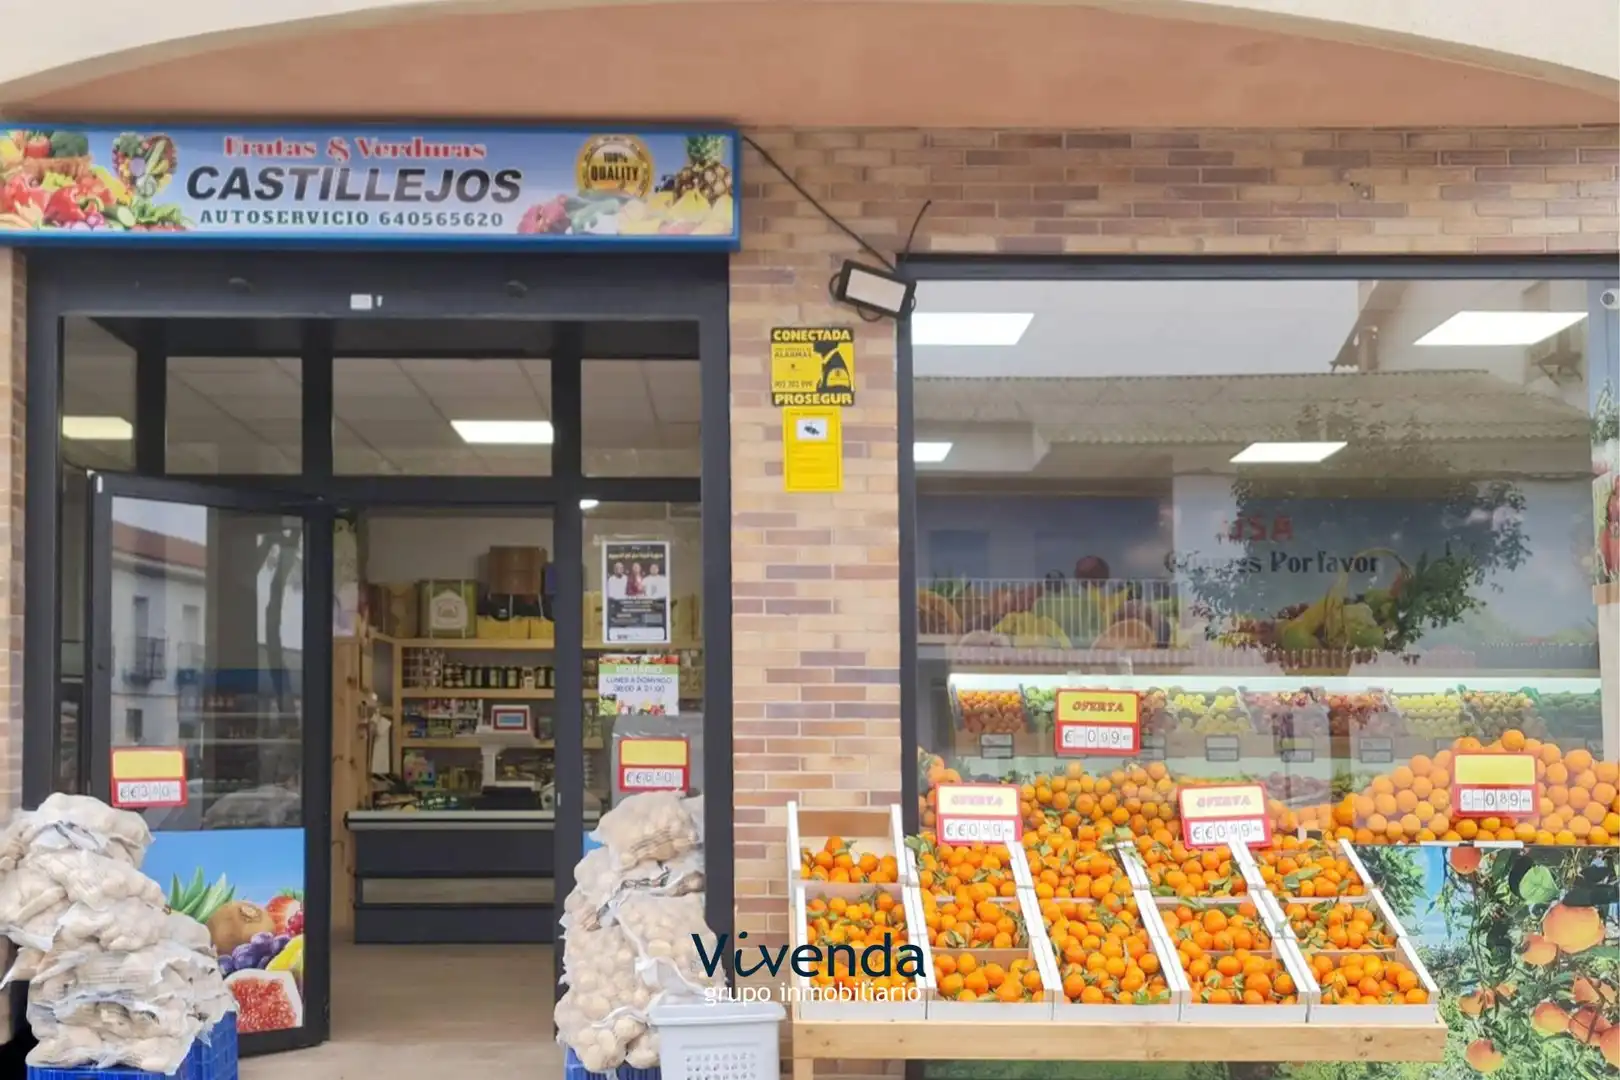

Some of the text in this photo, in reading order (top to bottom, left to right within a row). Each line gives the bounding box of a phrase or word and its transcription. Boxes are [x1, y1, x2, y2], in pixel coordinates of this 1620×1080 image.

[224, 136, 487, 161] Frutas & Verduras
[591, 166, 638, 181] QUALITY
[187, 166, 522, 203] CASTILLEJOS
[200, 210, 503, 226] AUTOSERVICIO 640565620
[773, 330, 851, 341] CONECTADA
[775, 393, 853, 405] PROSEGUR
[1072, 702, 1125, 712] OFERTA
